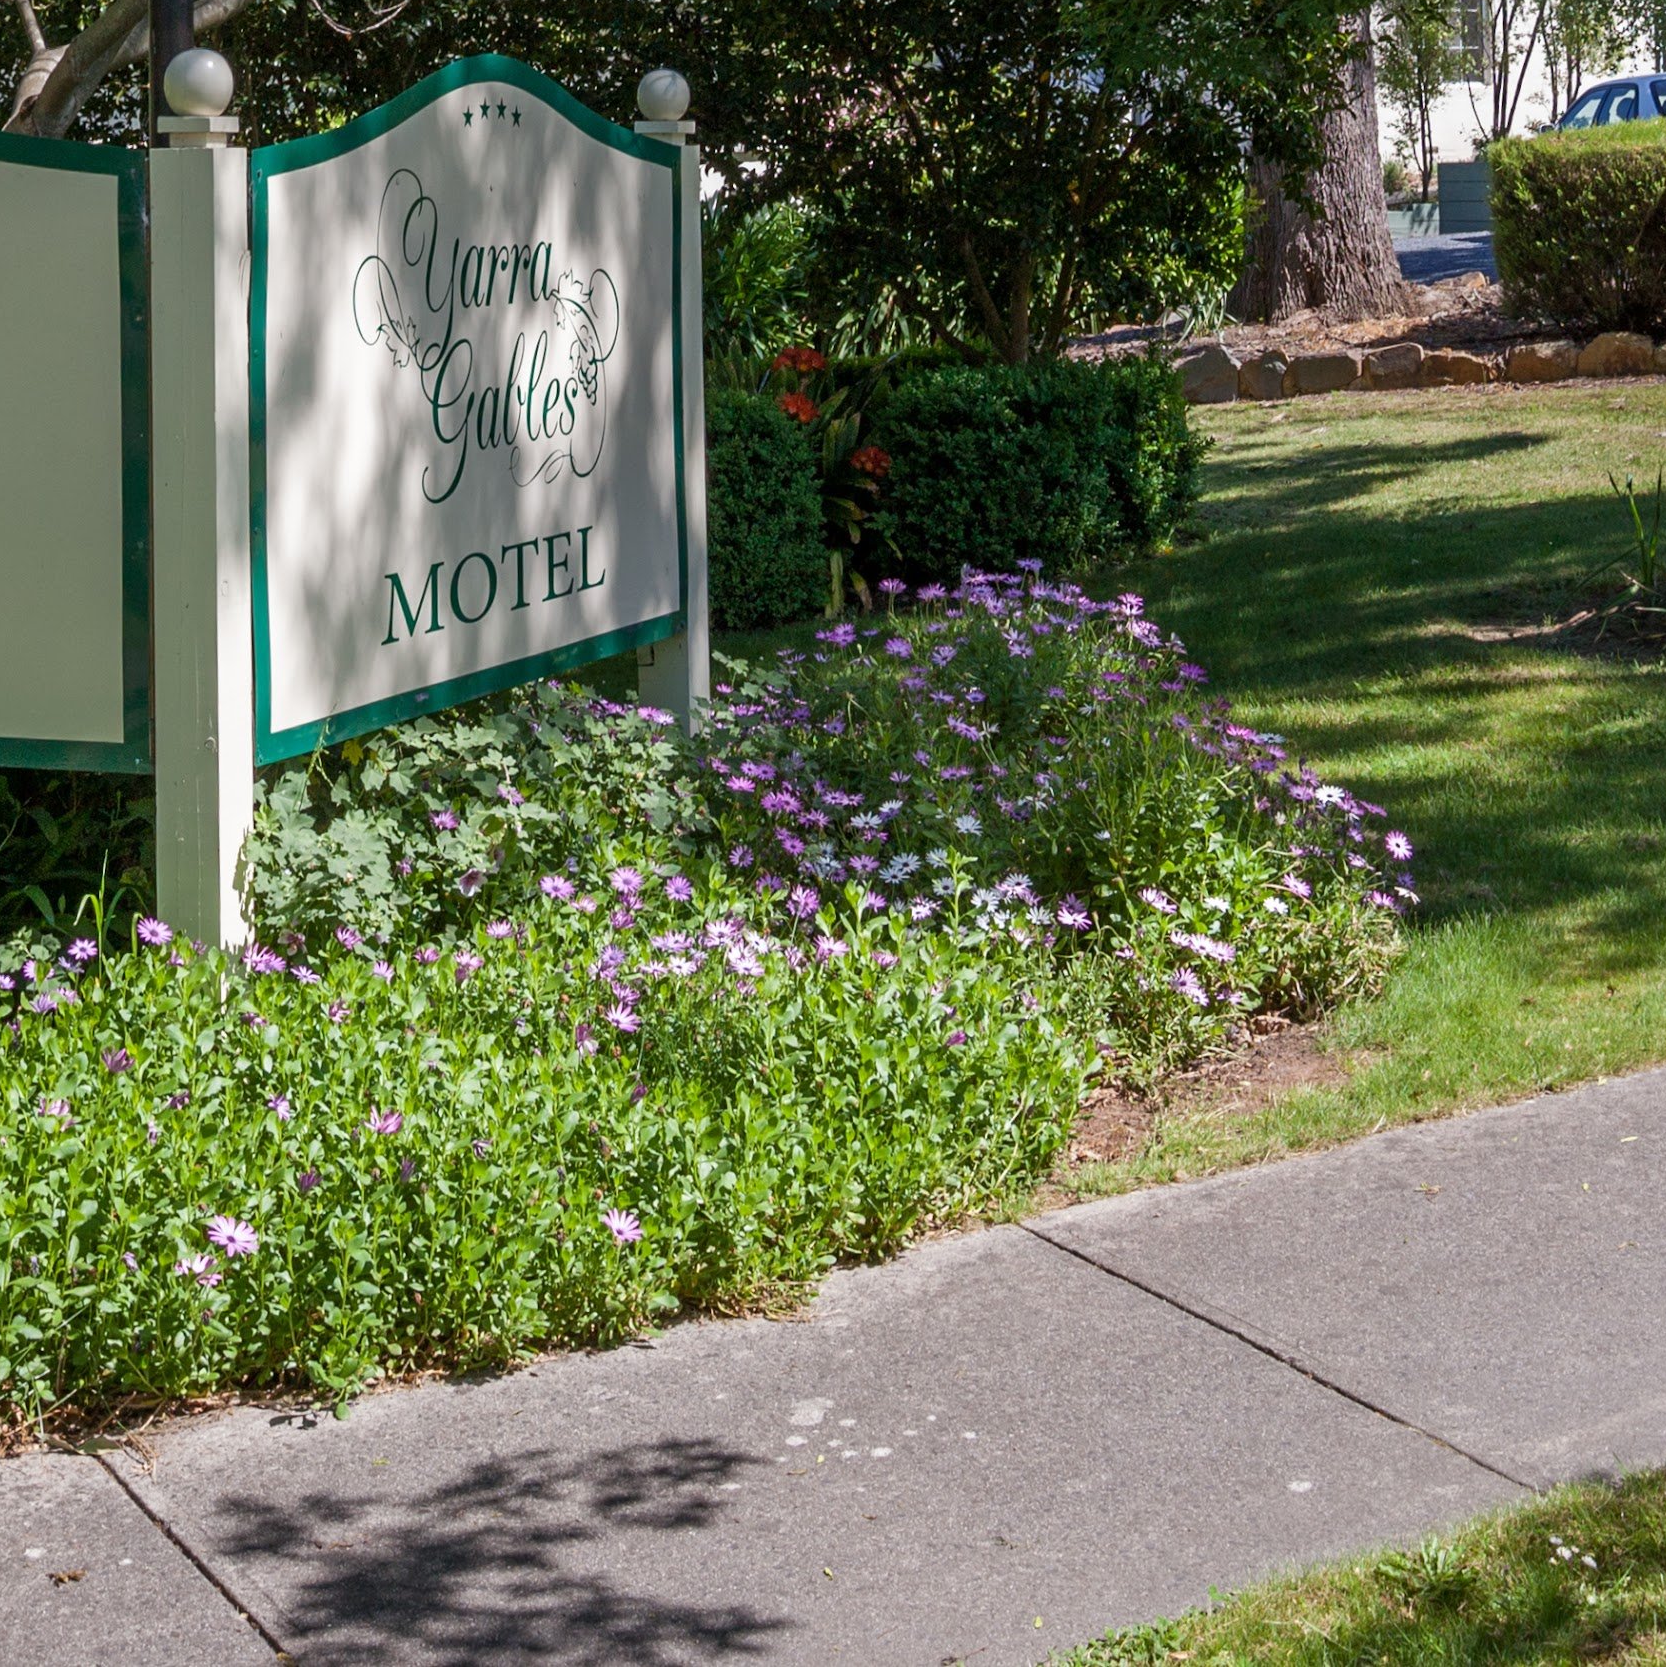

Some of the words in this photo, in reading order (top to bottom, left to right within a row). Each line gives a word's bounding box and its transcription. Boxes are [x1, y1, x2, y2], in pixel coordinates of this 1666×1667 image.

[403, 196, 555, 371] Yarra
[420, 330, 579, 504] Gables
[380, 526, 606, 645] MOTEL
